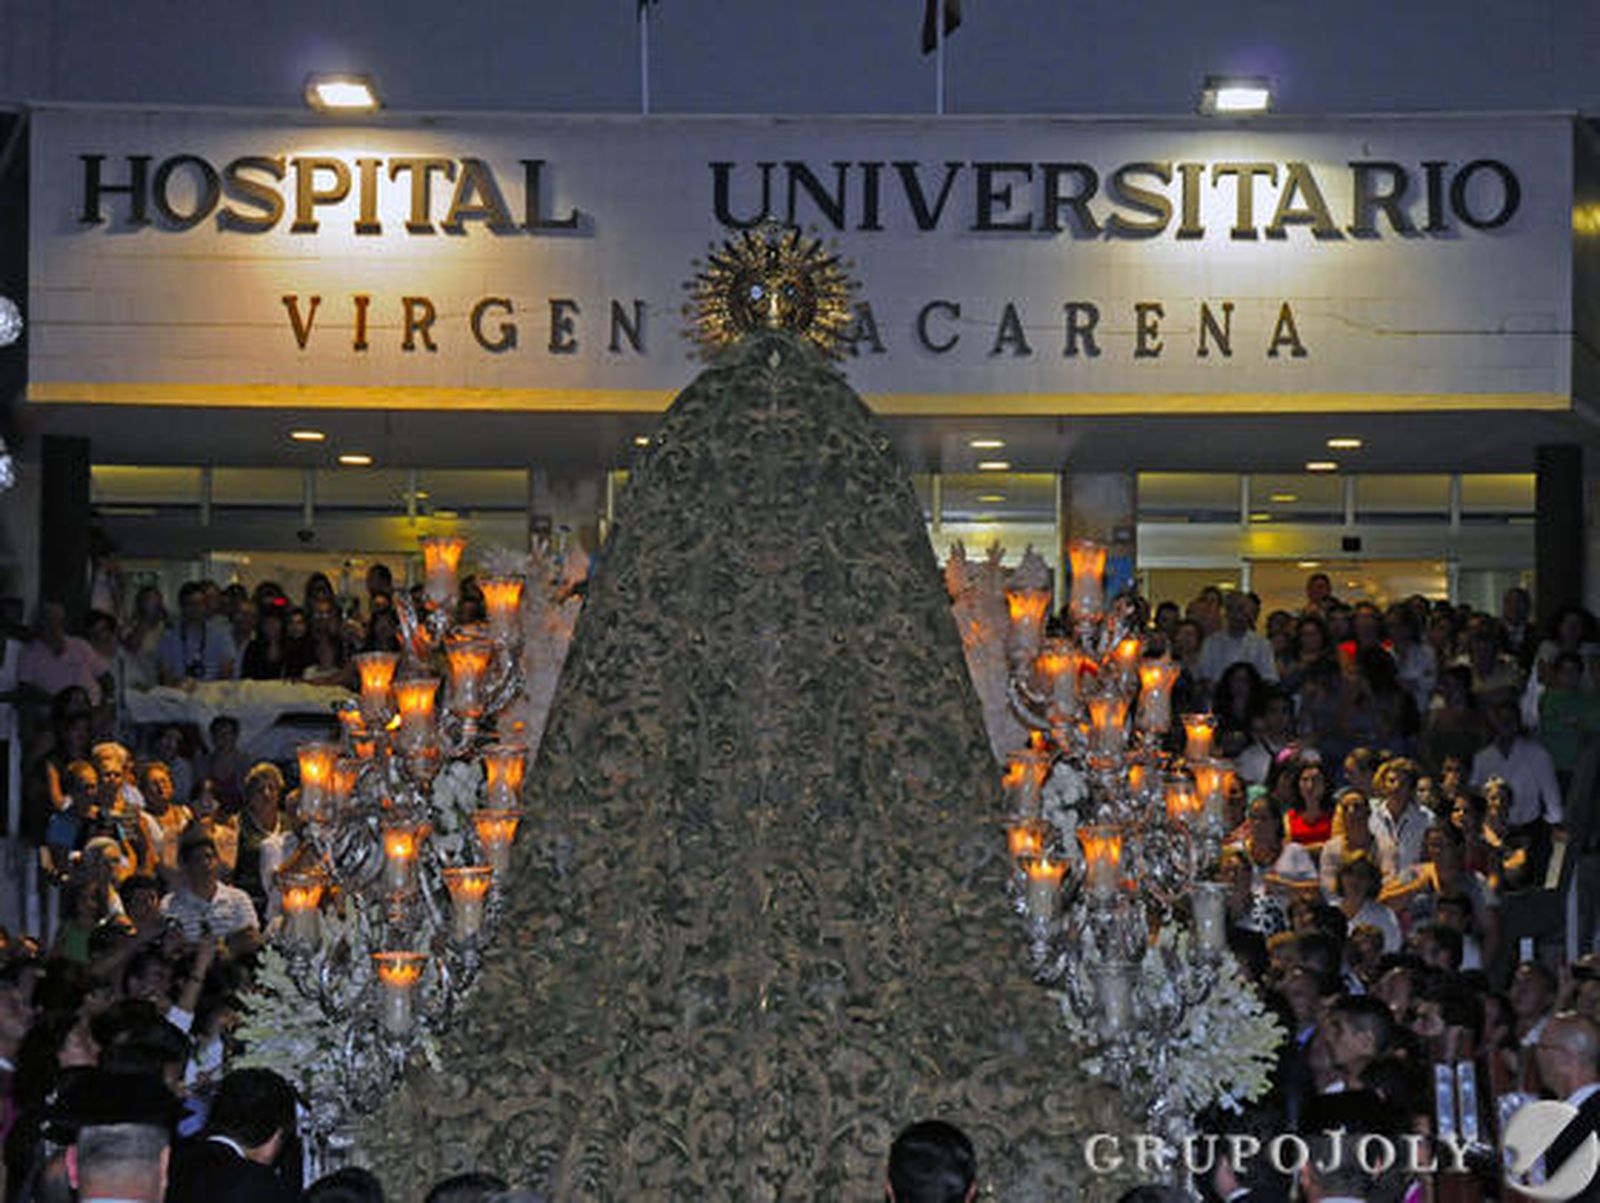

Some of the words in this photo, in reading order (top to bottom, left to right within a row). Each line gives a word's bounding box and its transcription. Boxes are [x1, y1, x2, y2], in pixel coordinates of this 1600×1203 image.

[79, 154, 580, 235] HOSPITAL
[708, 158, 1522, 240] UNIVERSITARIO
[282, 294, 648, 354] VIRGEN
[842, 300, 1308, 358] ACARENA
